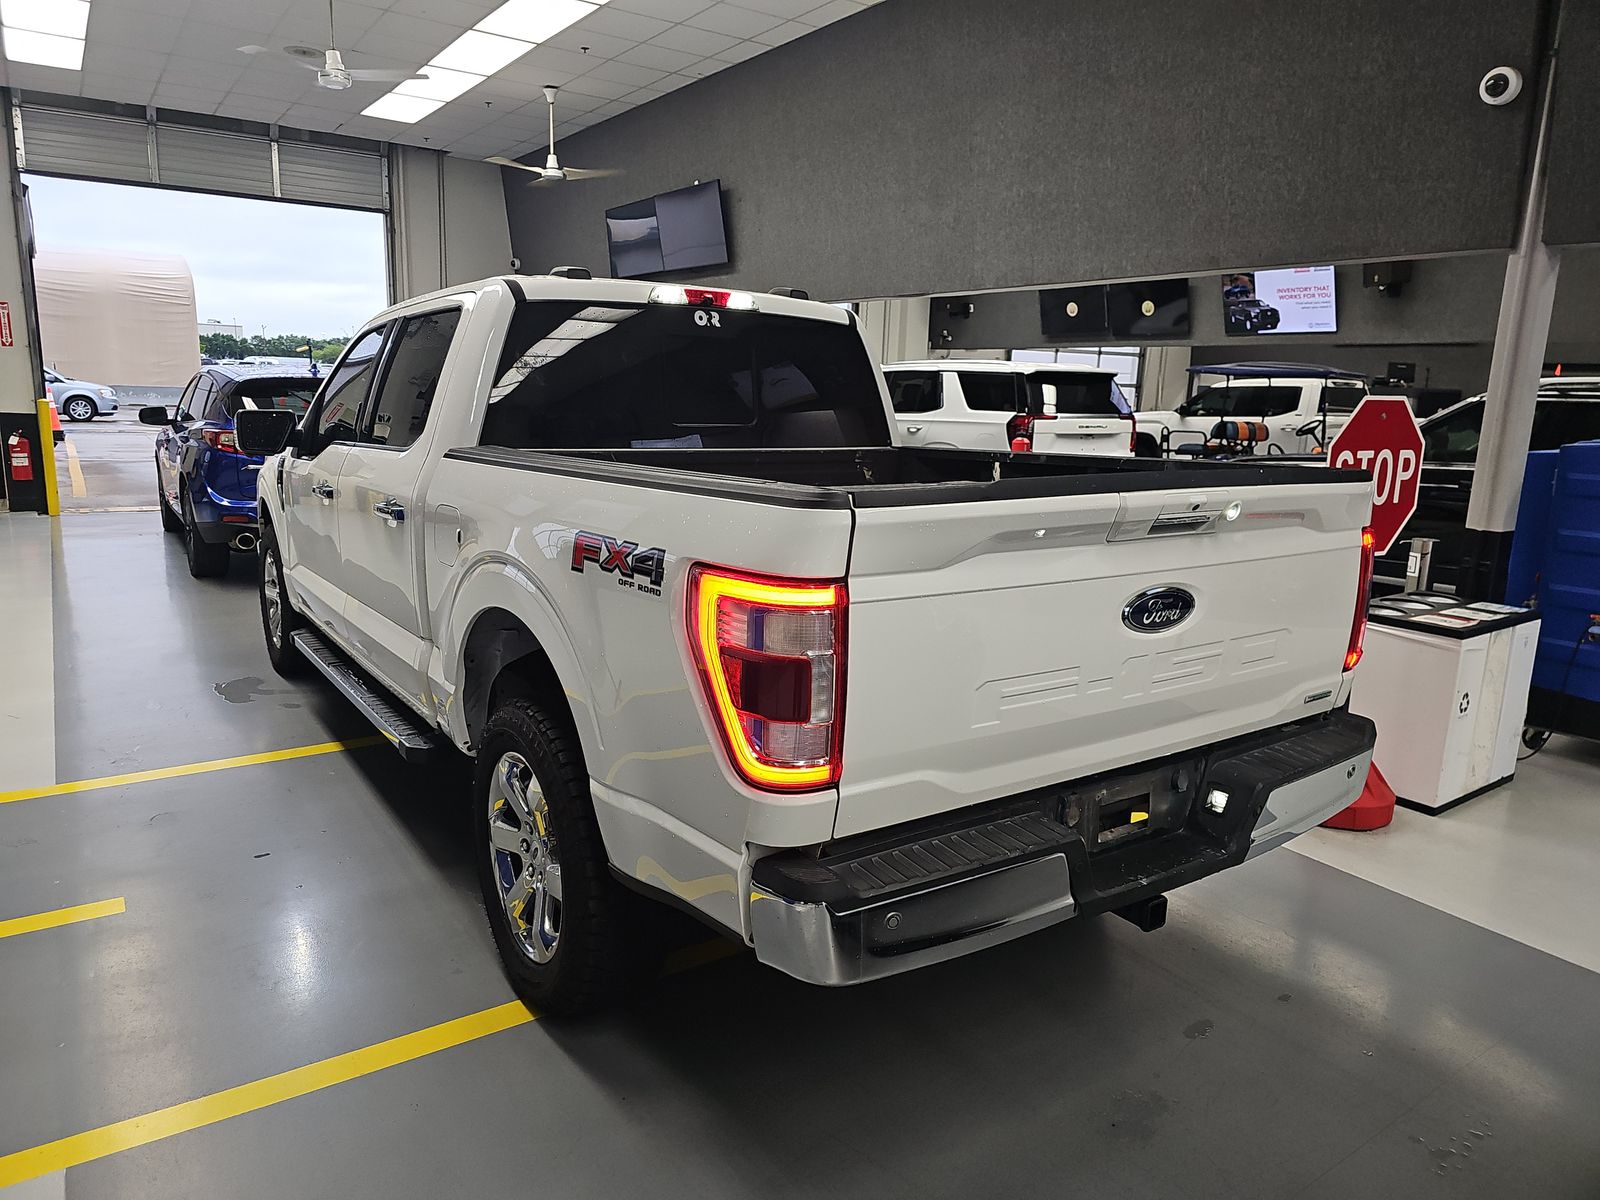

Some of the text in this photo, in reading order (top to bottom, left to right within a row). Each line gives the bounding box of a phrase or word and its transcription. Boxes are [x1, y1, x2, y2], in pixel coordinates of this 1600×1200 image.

[571, 530, 667, 587] FX4
[618, 578, 662, 597] OFF ROAD
[1143, 598, 1182, 624] Ford
[971, 628, 1293, 728] F-150
